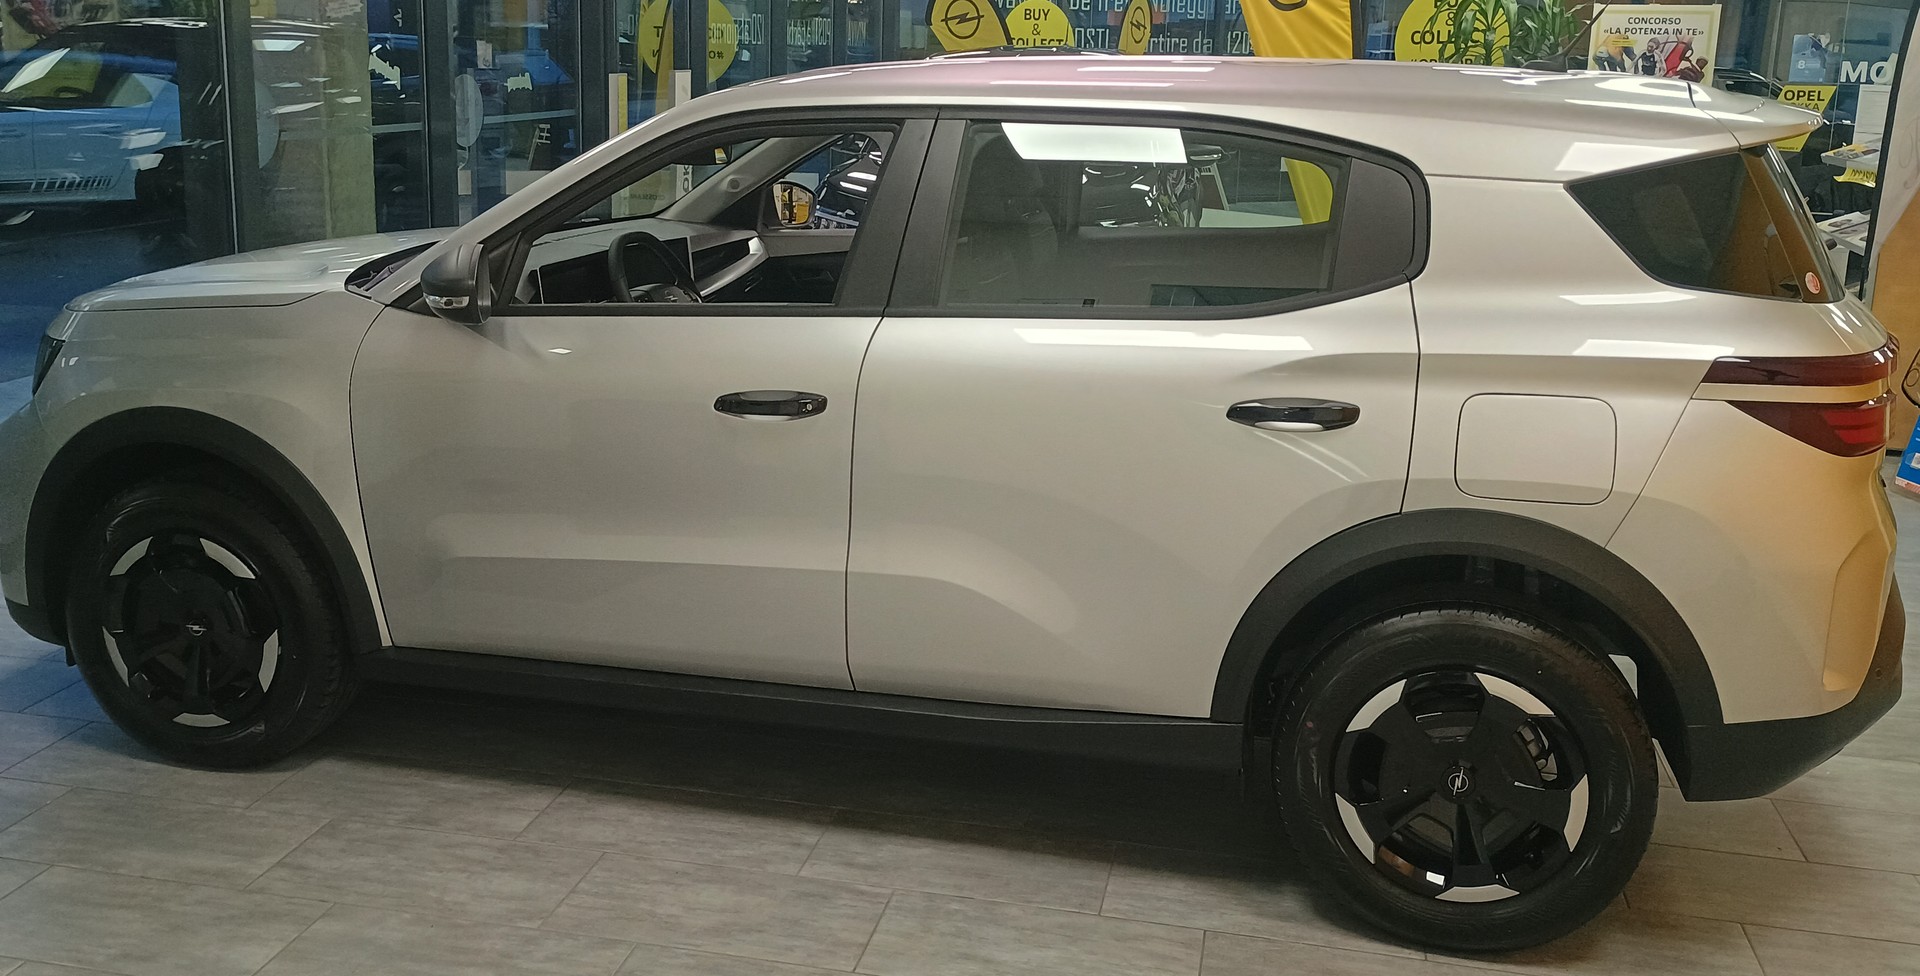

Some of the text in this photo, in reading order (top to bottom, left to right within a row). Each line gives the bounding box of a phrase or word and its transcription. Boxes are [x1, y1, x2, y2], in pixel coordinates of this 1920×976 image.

[1024, 8, 1050, 21] BUY
[1627, 17, 1682, 25] CONCORSO
[1032, 23, 1041, 36] &
[1624, 27, 1669, 36] POTENZA
[1672, 28, 1683, 36] IN
[1074, 28, 1109, 48] OSTI
[1146, 32, 1188, 53] rtire
[1193, 30, 1213, 54] da
[1783, 89, 1825, 101] OPEL
